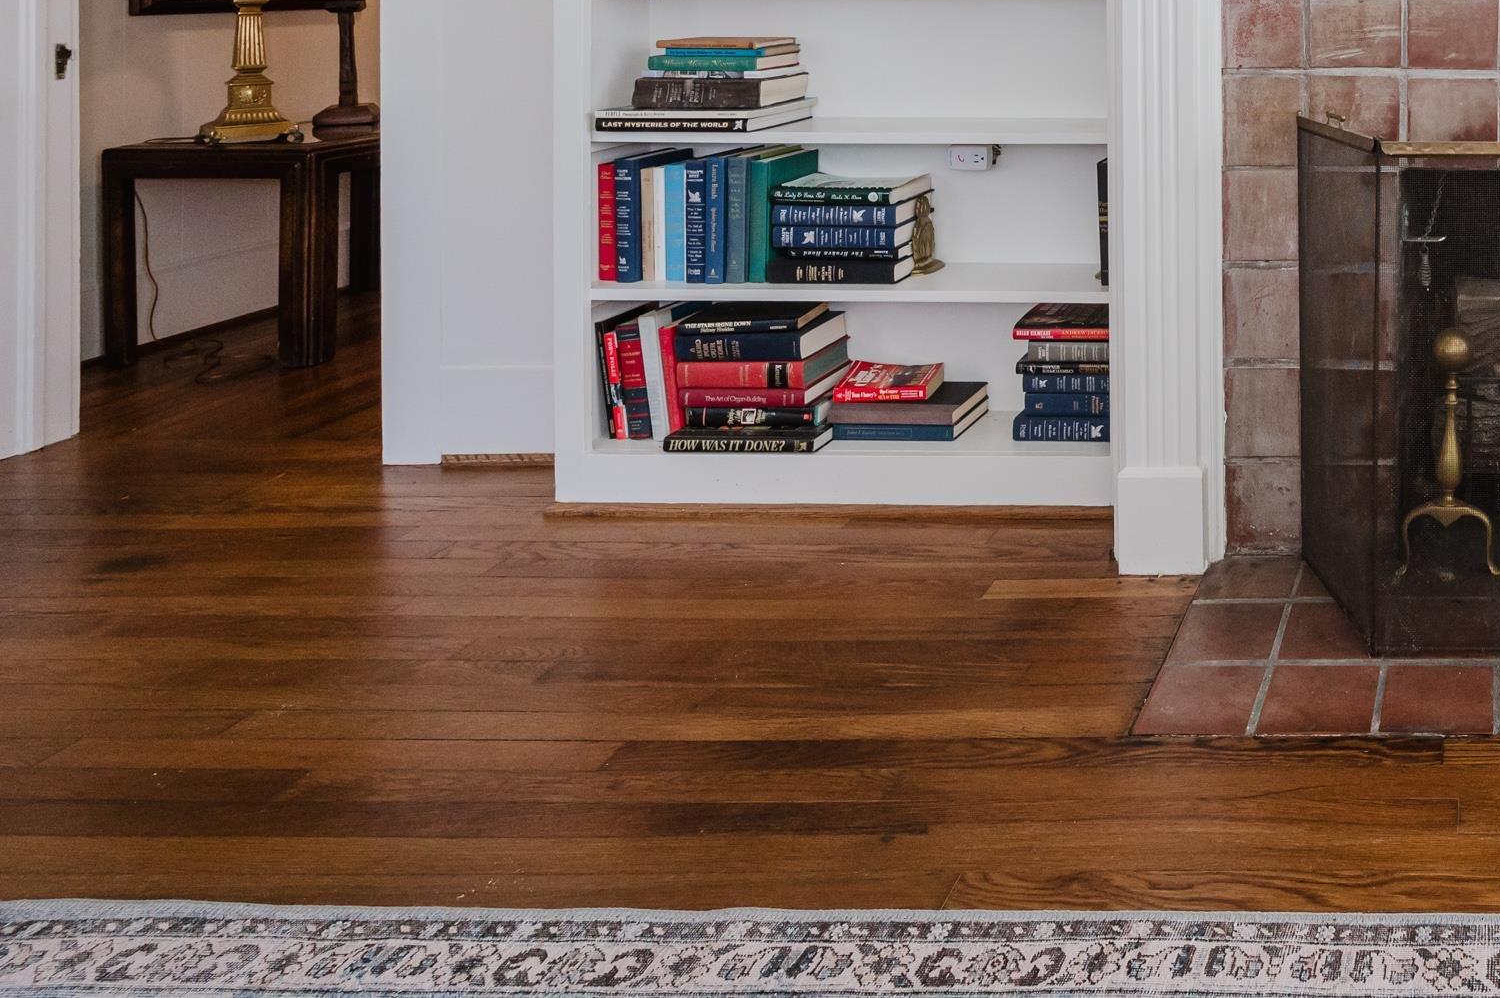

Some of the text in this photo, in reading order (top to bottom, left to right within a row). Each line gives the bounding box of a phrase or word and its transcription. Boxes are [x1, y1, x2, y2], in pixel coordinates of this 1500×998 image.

[711, 183, 719, 200] Bush
[609, 356, 617, 377] FOLLY
[860, 392, 877, 400] Clancy's
[669, 440, 786, 451] HOW WAS IT DONE?
